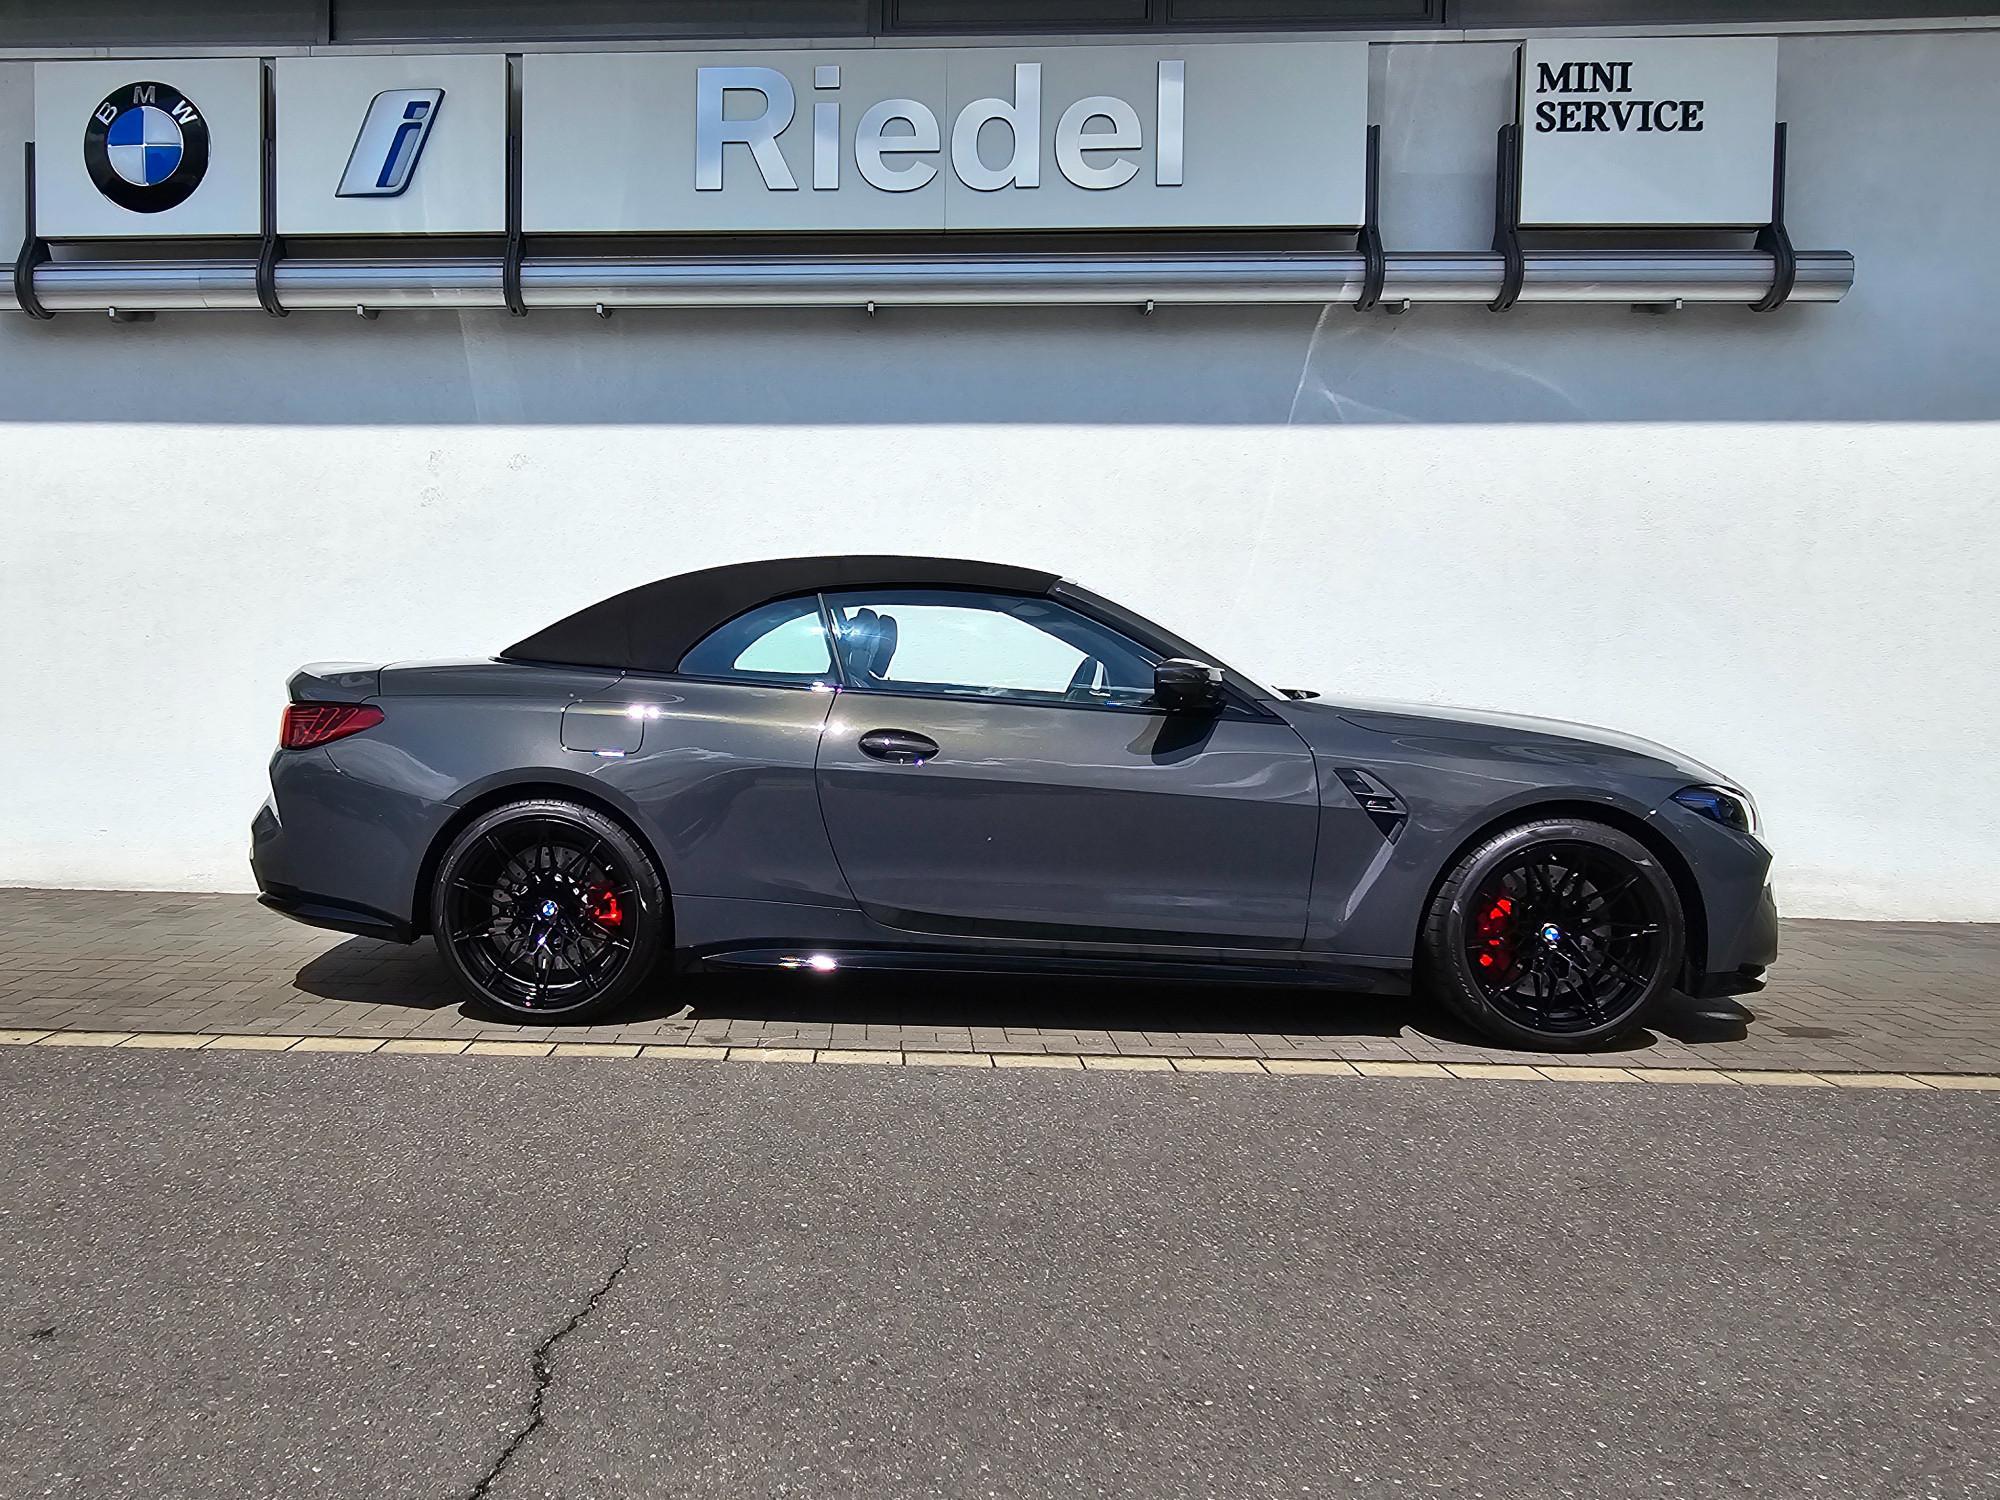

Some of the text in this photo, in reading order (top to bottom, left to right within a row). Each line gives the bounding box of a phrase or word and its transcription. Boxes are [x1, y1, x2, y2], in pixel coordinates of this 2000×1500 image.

[1536, 62, 1633, 93] MINI
[95, 86, 198, 126] BMW
[695, 60, 1185, 192] Riedel
[1535, 100, 1704, 133] SERVICE
[375, 101, 431, 188] i
